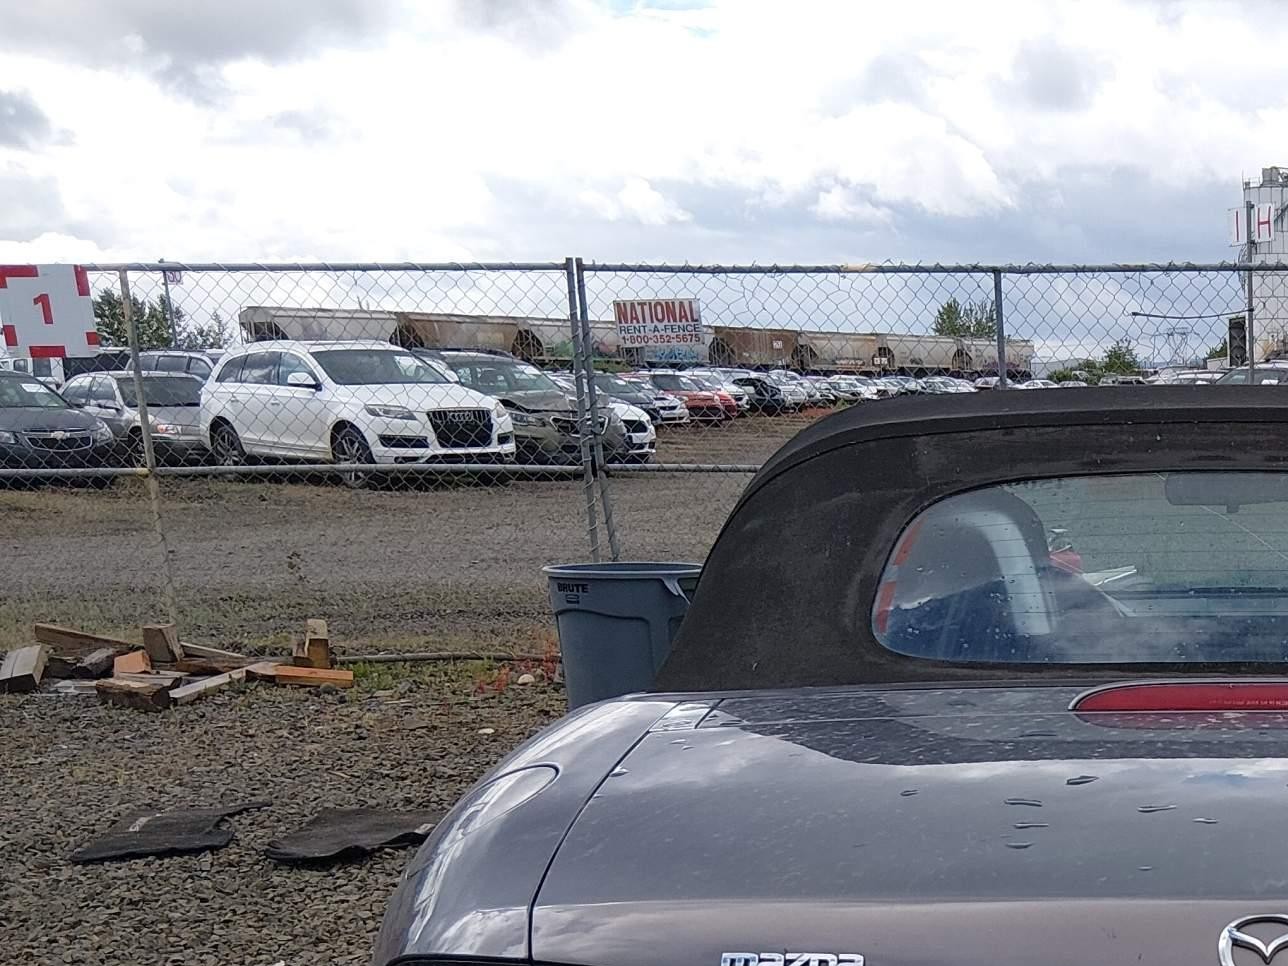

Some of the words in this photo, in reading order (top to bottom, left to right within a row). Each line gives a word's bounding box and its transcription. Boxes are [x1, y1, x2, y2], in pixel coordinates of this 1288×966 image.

[1257, 205, 1272, 240] H
[33, 293, 54, 325] 1
[616, 300, 699, 324] NATIONAL
[619, 323, 701, 335] RENT-A-FENCE
[622, 333, 701, 345] 1-800-352-5675
[557, 582, 589, 593] BRUTE
